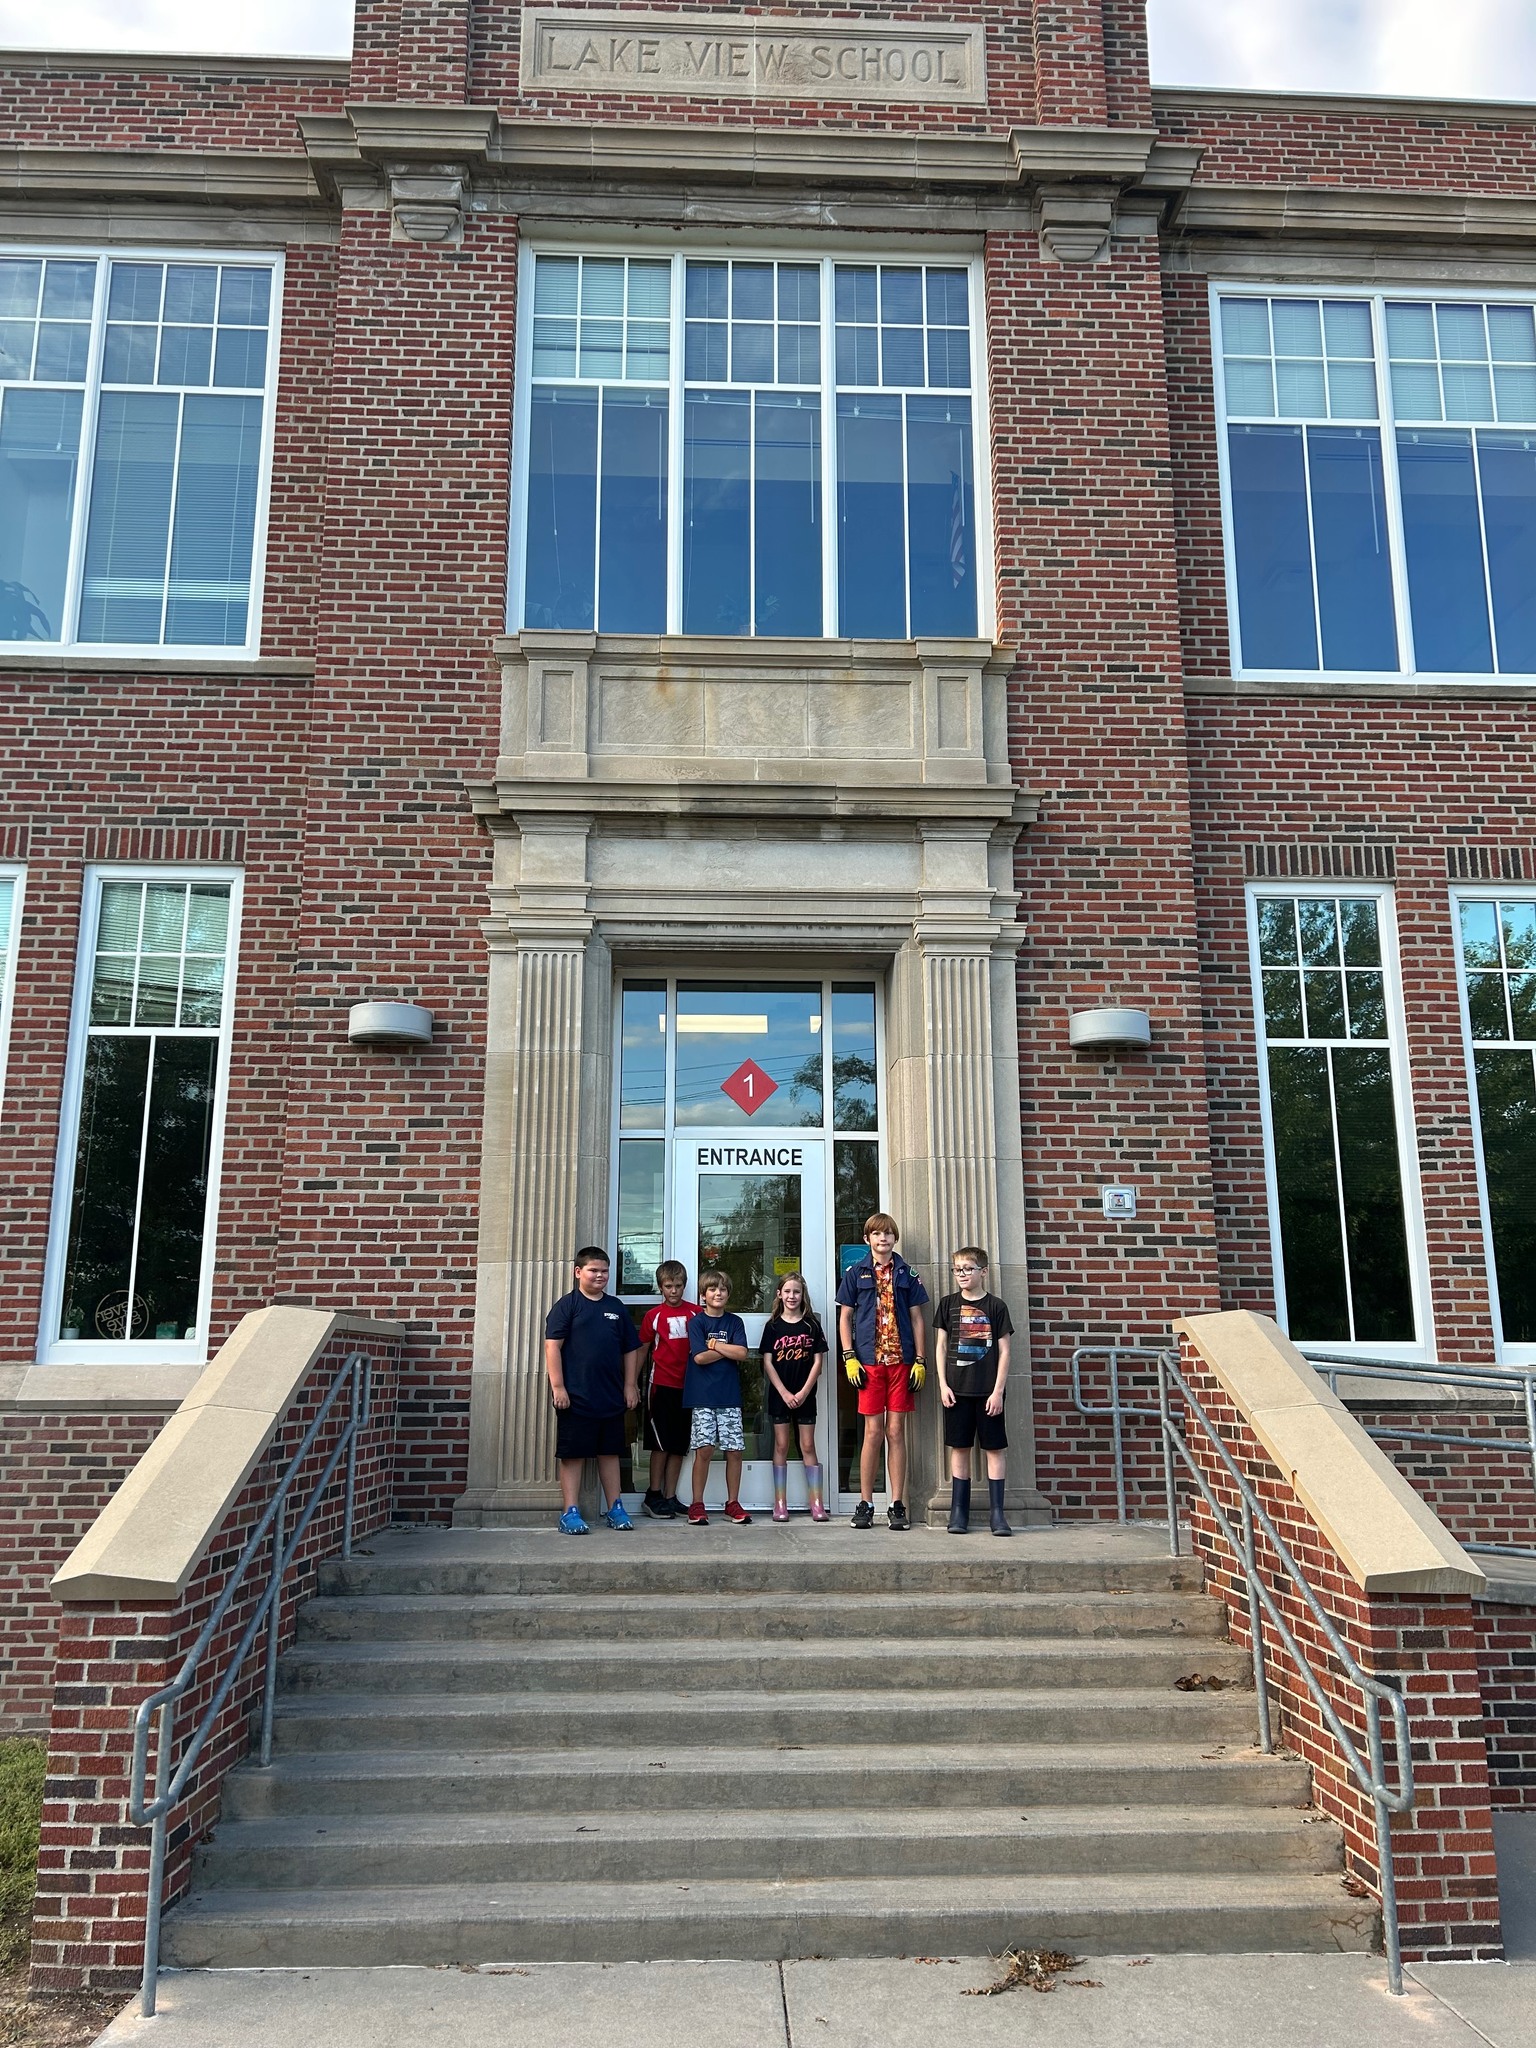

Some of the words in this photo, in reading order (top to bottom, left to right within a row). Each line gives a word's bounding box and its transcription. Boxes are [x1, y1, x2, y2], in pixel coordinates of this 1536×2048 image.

[545, 35, 662, 75] LAKE
[682, 39, 791, 78] VIEW
[810, 45, 962, 85] SCHOOL
[743, 1073, 754, 1098] 1
[697, 1148, 803, 1166] ENTRANCE
[666, 1315, 689, 1340] N
[773, 1333, 815, 1350] CREATE
[776, 1348, 810, 1362] 2025
